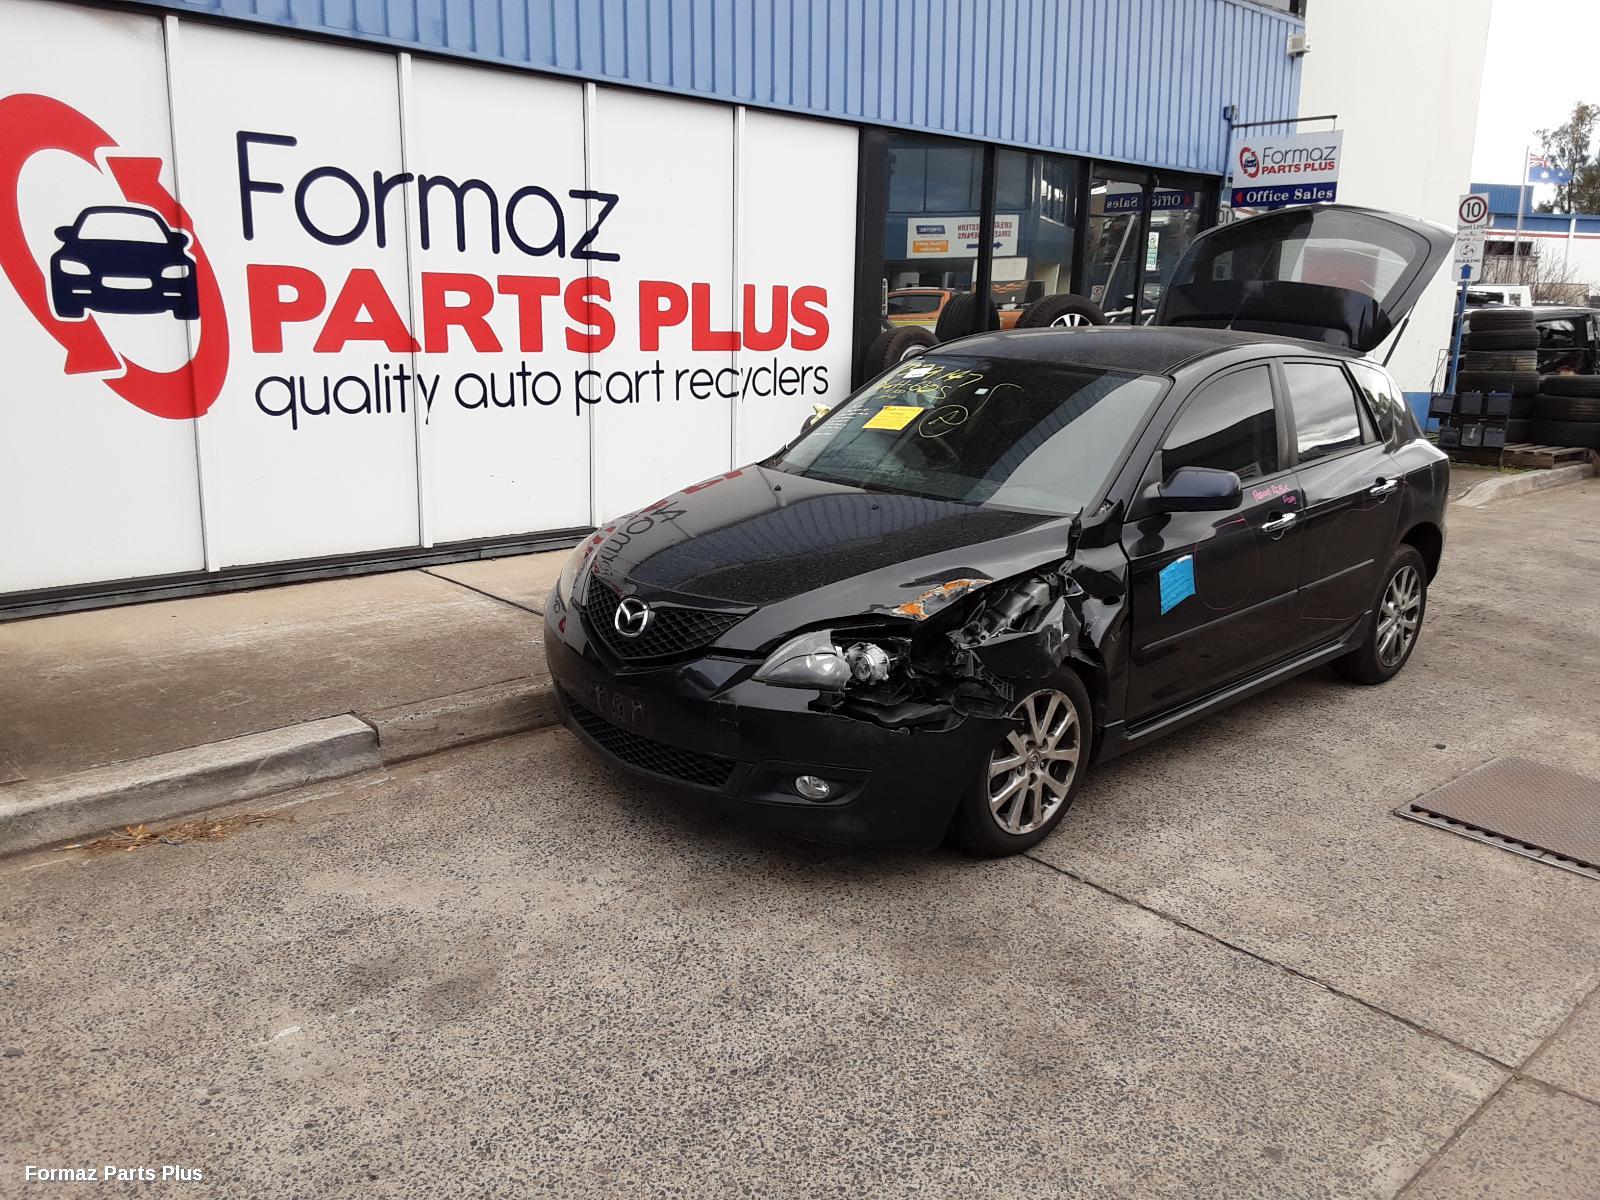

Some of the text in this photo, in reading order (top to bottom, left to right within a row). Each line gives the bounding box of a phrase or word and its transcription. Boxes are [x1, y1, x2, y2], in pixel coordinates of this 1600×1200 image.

[1262, 146, 1337, 166] Formaz
[1261, 161, 1336, 175] PARTS PLUS
[236, 130, 622, 263] Formaz
[1246, 187, 1334, 203] Office Sales
[1466, 201, 1482, 219] 10
[247, 264, 830, 354] PARTS PLUS
[255, 357, 829, 431] quality auto part recyclers
